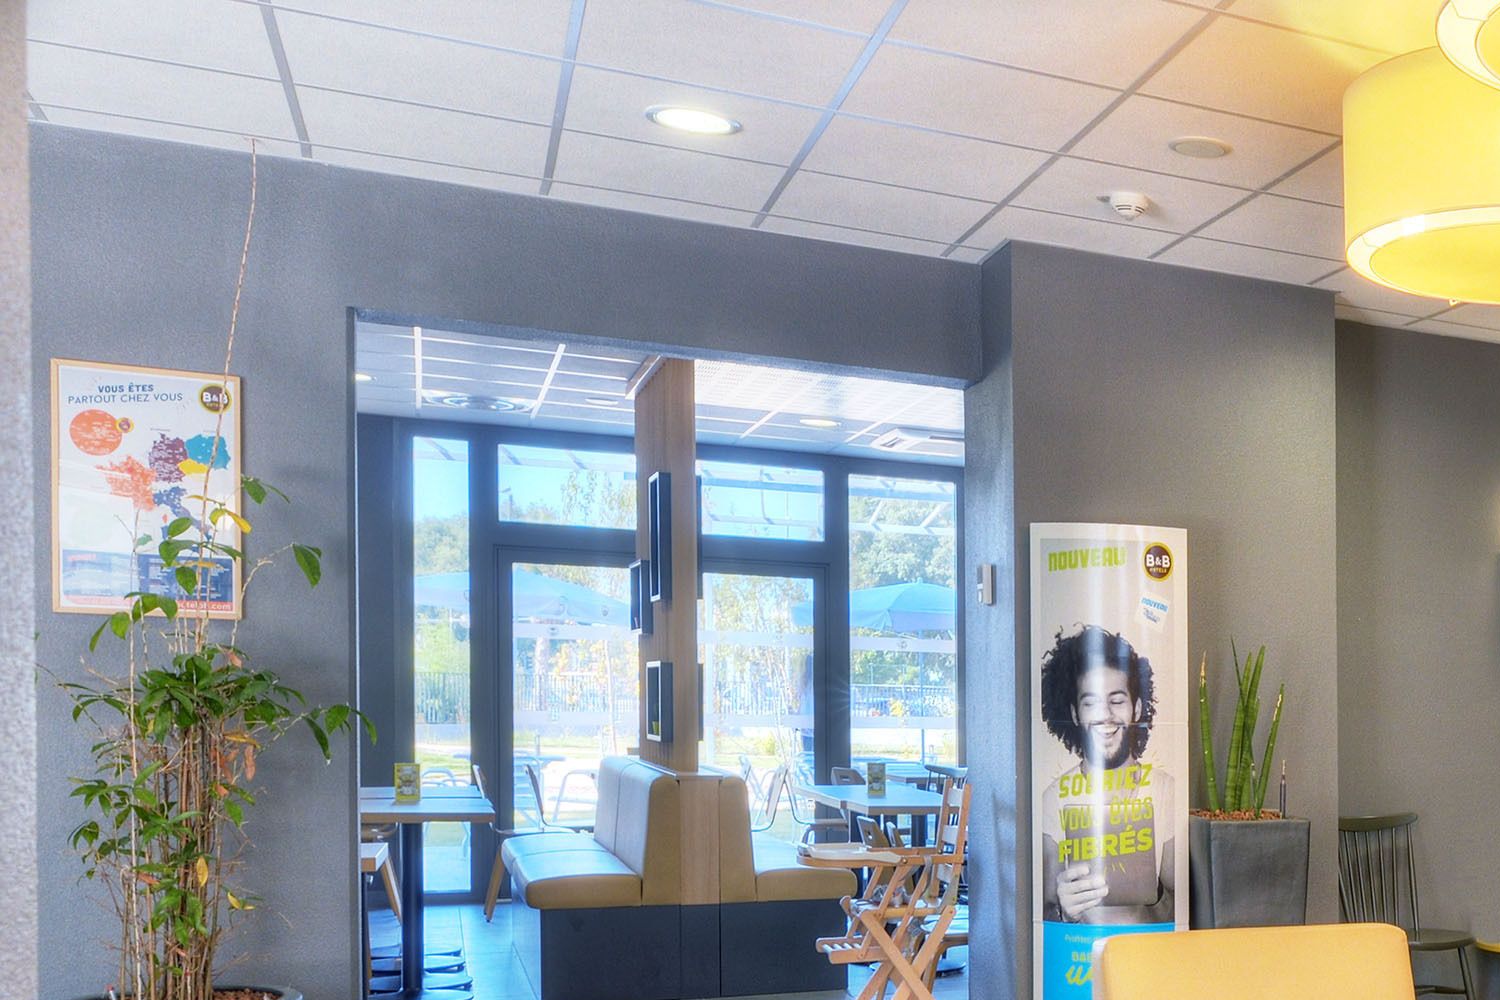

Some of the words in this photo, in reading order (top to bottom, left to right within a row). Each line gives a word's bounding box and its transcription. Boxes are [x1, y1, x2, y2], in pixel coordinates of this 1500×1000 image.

[68, 394, 120, 404] PARTOUT
[121, 394, 150, 403] CHEZ
[153, 393, 183, 401] VOUS
[98, 385, 124, 393] VOUS
[128, 383, 154, 392] ÊTES
[1145, 554, 1171, 568] B&B
[1058, 763, 1153, 798] SOURIEZ
[1059, 804, 1101, 832] VOU
[1058, 825, 1153, 863] FIBRÉS
